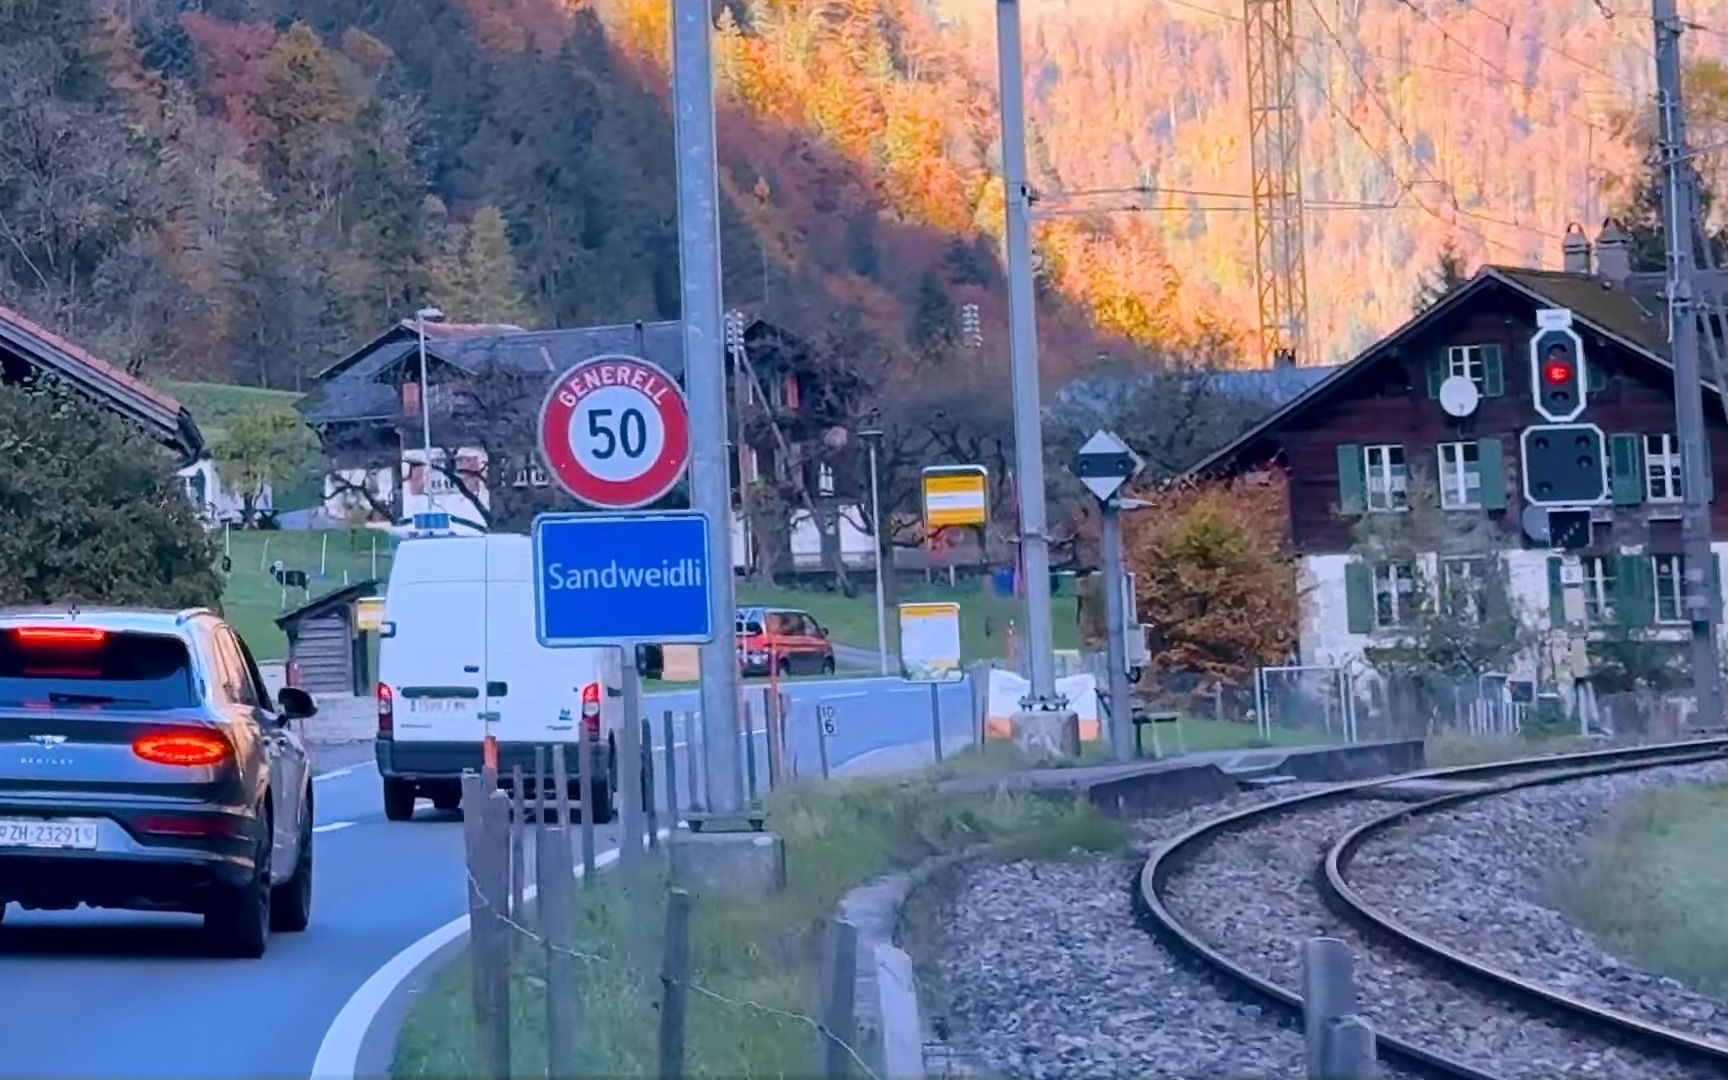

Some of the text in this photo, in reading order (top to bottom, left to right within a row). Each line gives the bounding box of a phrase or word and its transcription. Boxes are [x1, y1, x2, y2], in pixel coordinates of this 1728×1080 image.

[558, 365, 670, 408] GENERELL
[587, 408, 647, 459] 50
[548, 558, 702, 590] Sandweidli
